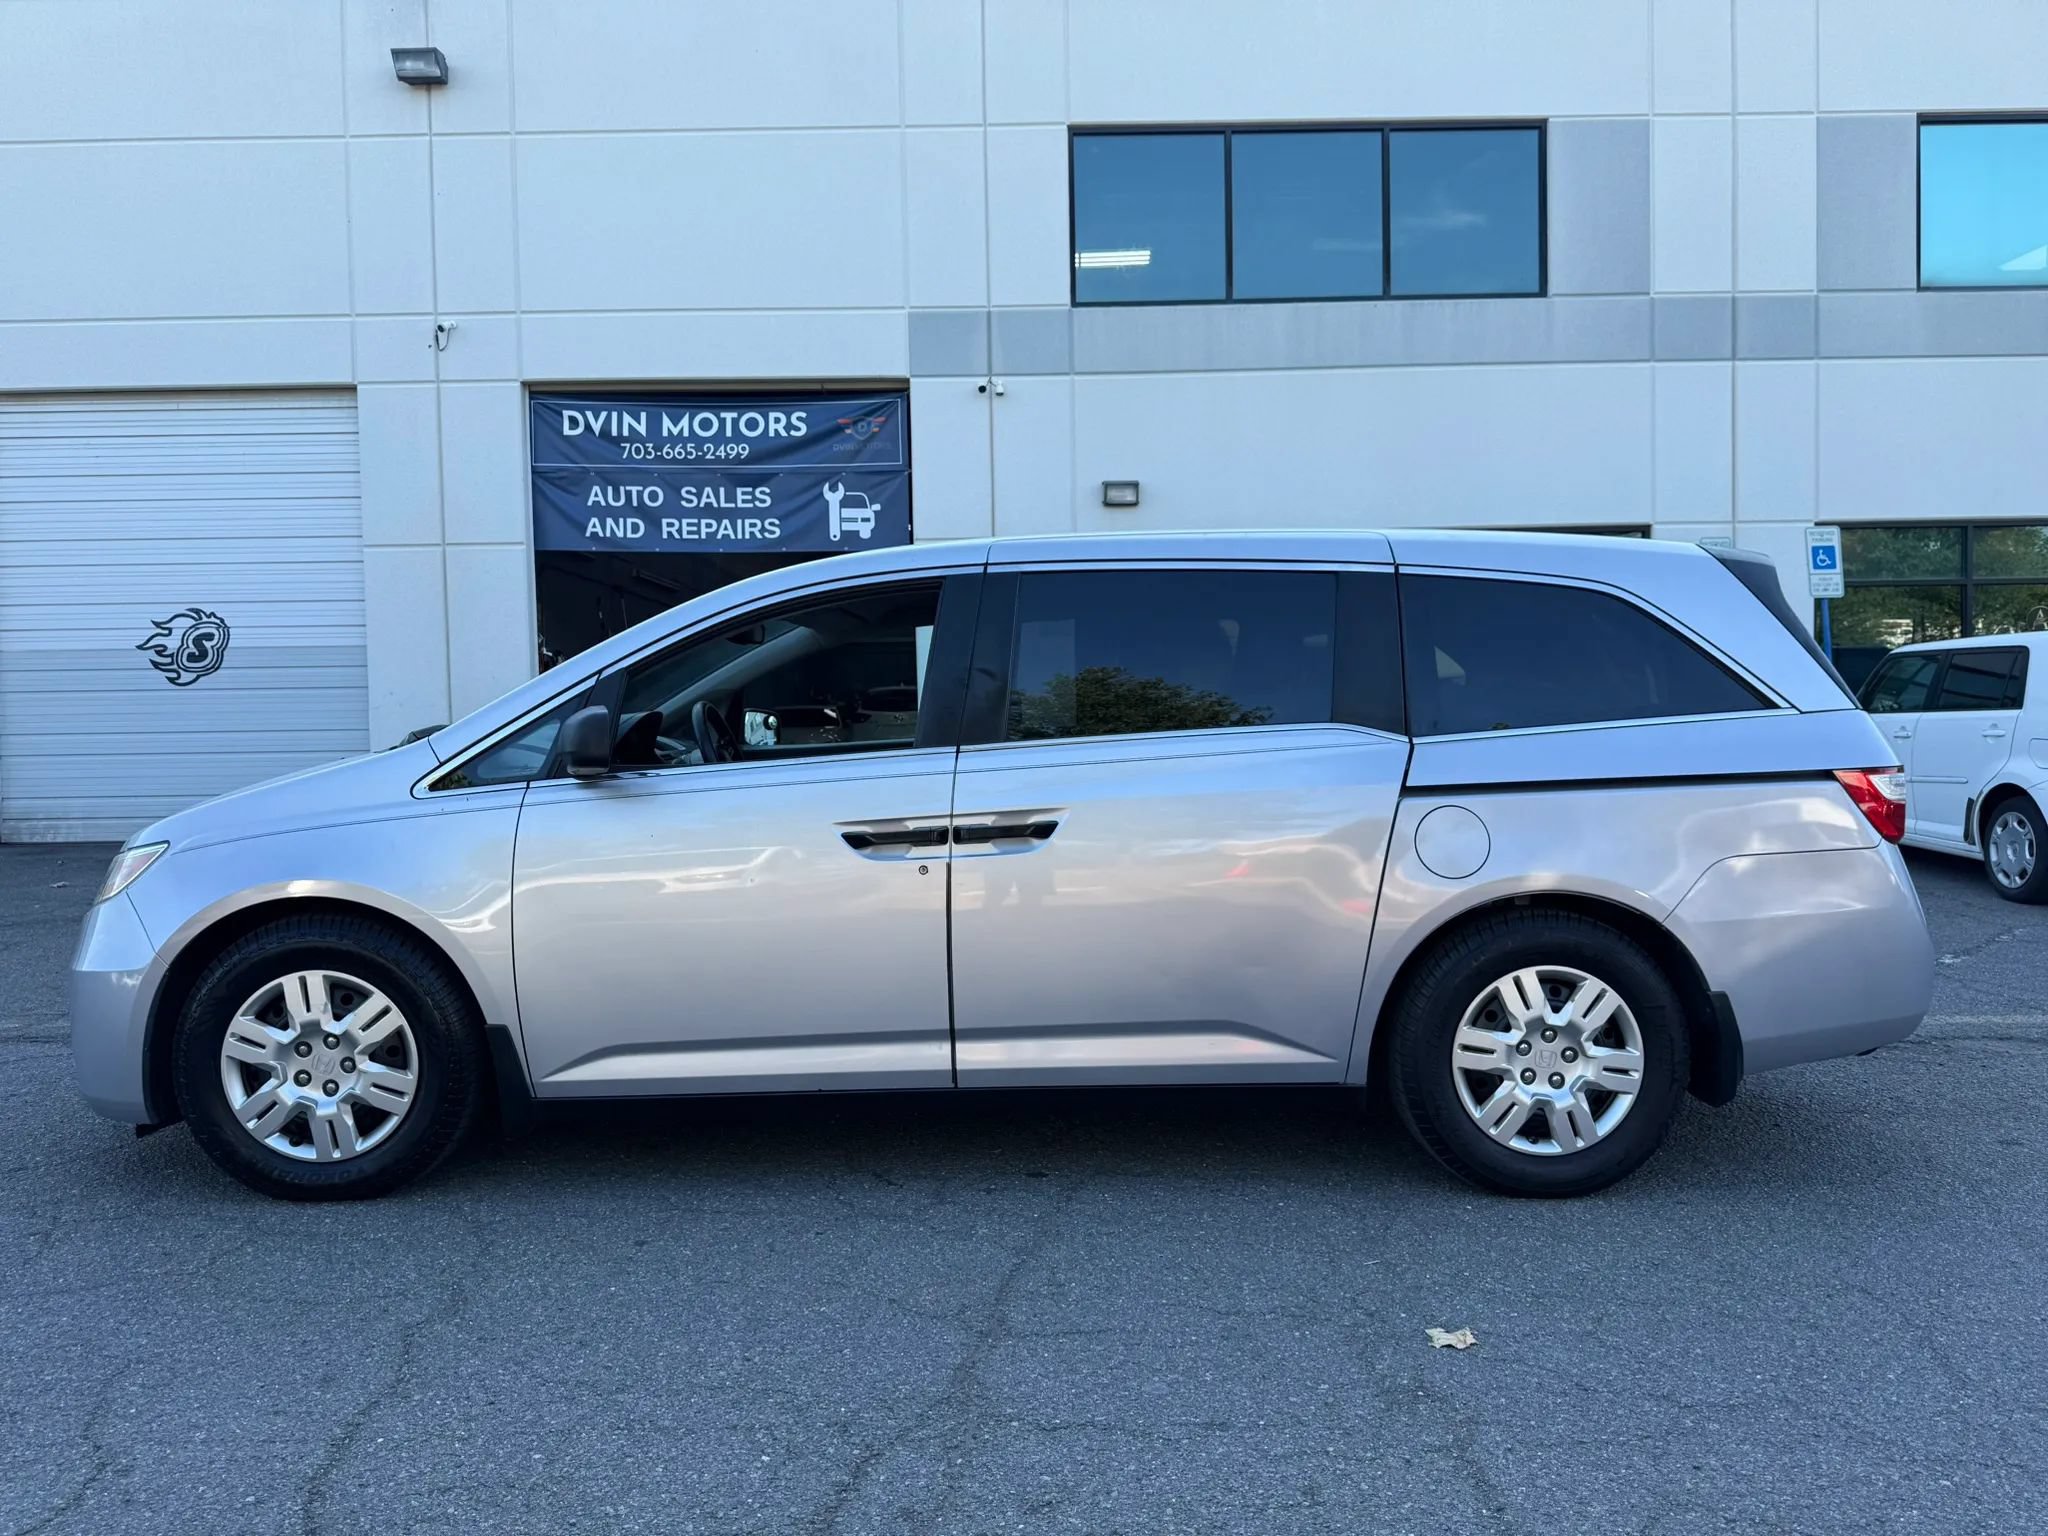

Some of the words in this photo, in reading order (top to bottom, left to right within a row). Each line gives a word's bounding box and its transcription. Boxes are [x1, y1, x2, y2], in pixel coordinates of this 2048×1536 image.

[562, 409, 647, 438] DVIN
[662, 410, 808, 438] MOTORS
[620, 443, 750, 460] 703-665-2499
[587, 485, 664, 507] AUTO
[680, 486, 772, 508] SALES
[585, 517, 645, 539] AND
[661, 518, 781, 540] REPAIRS
